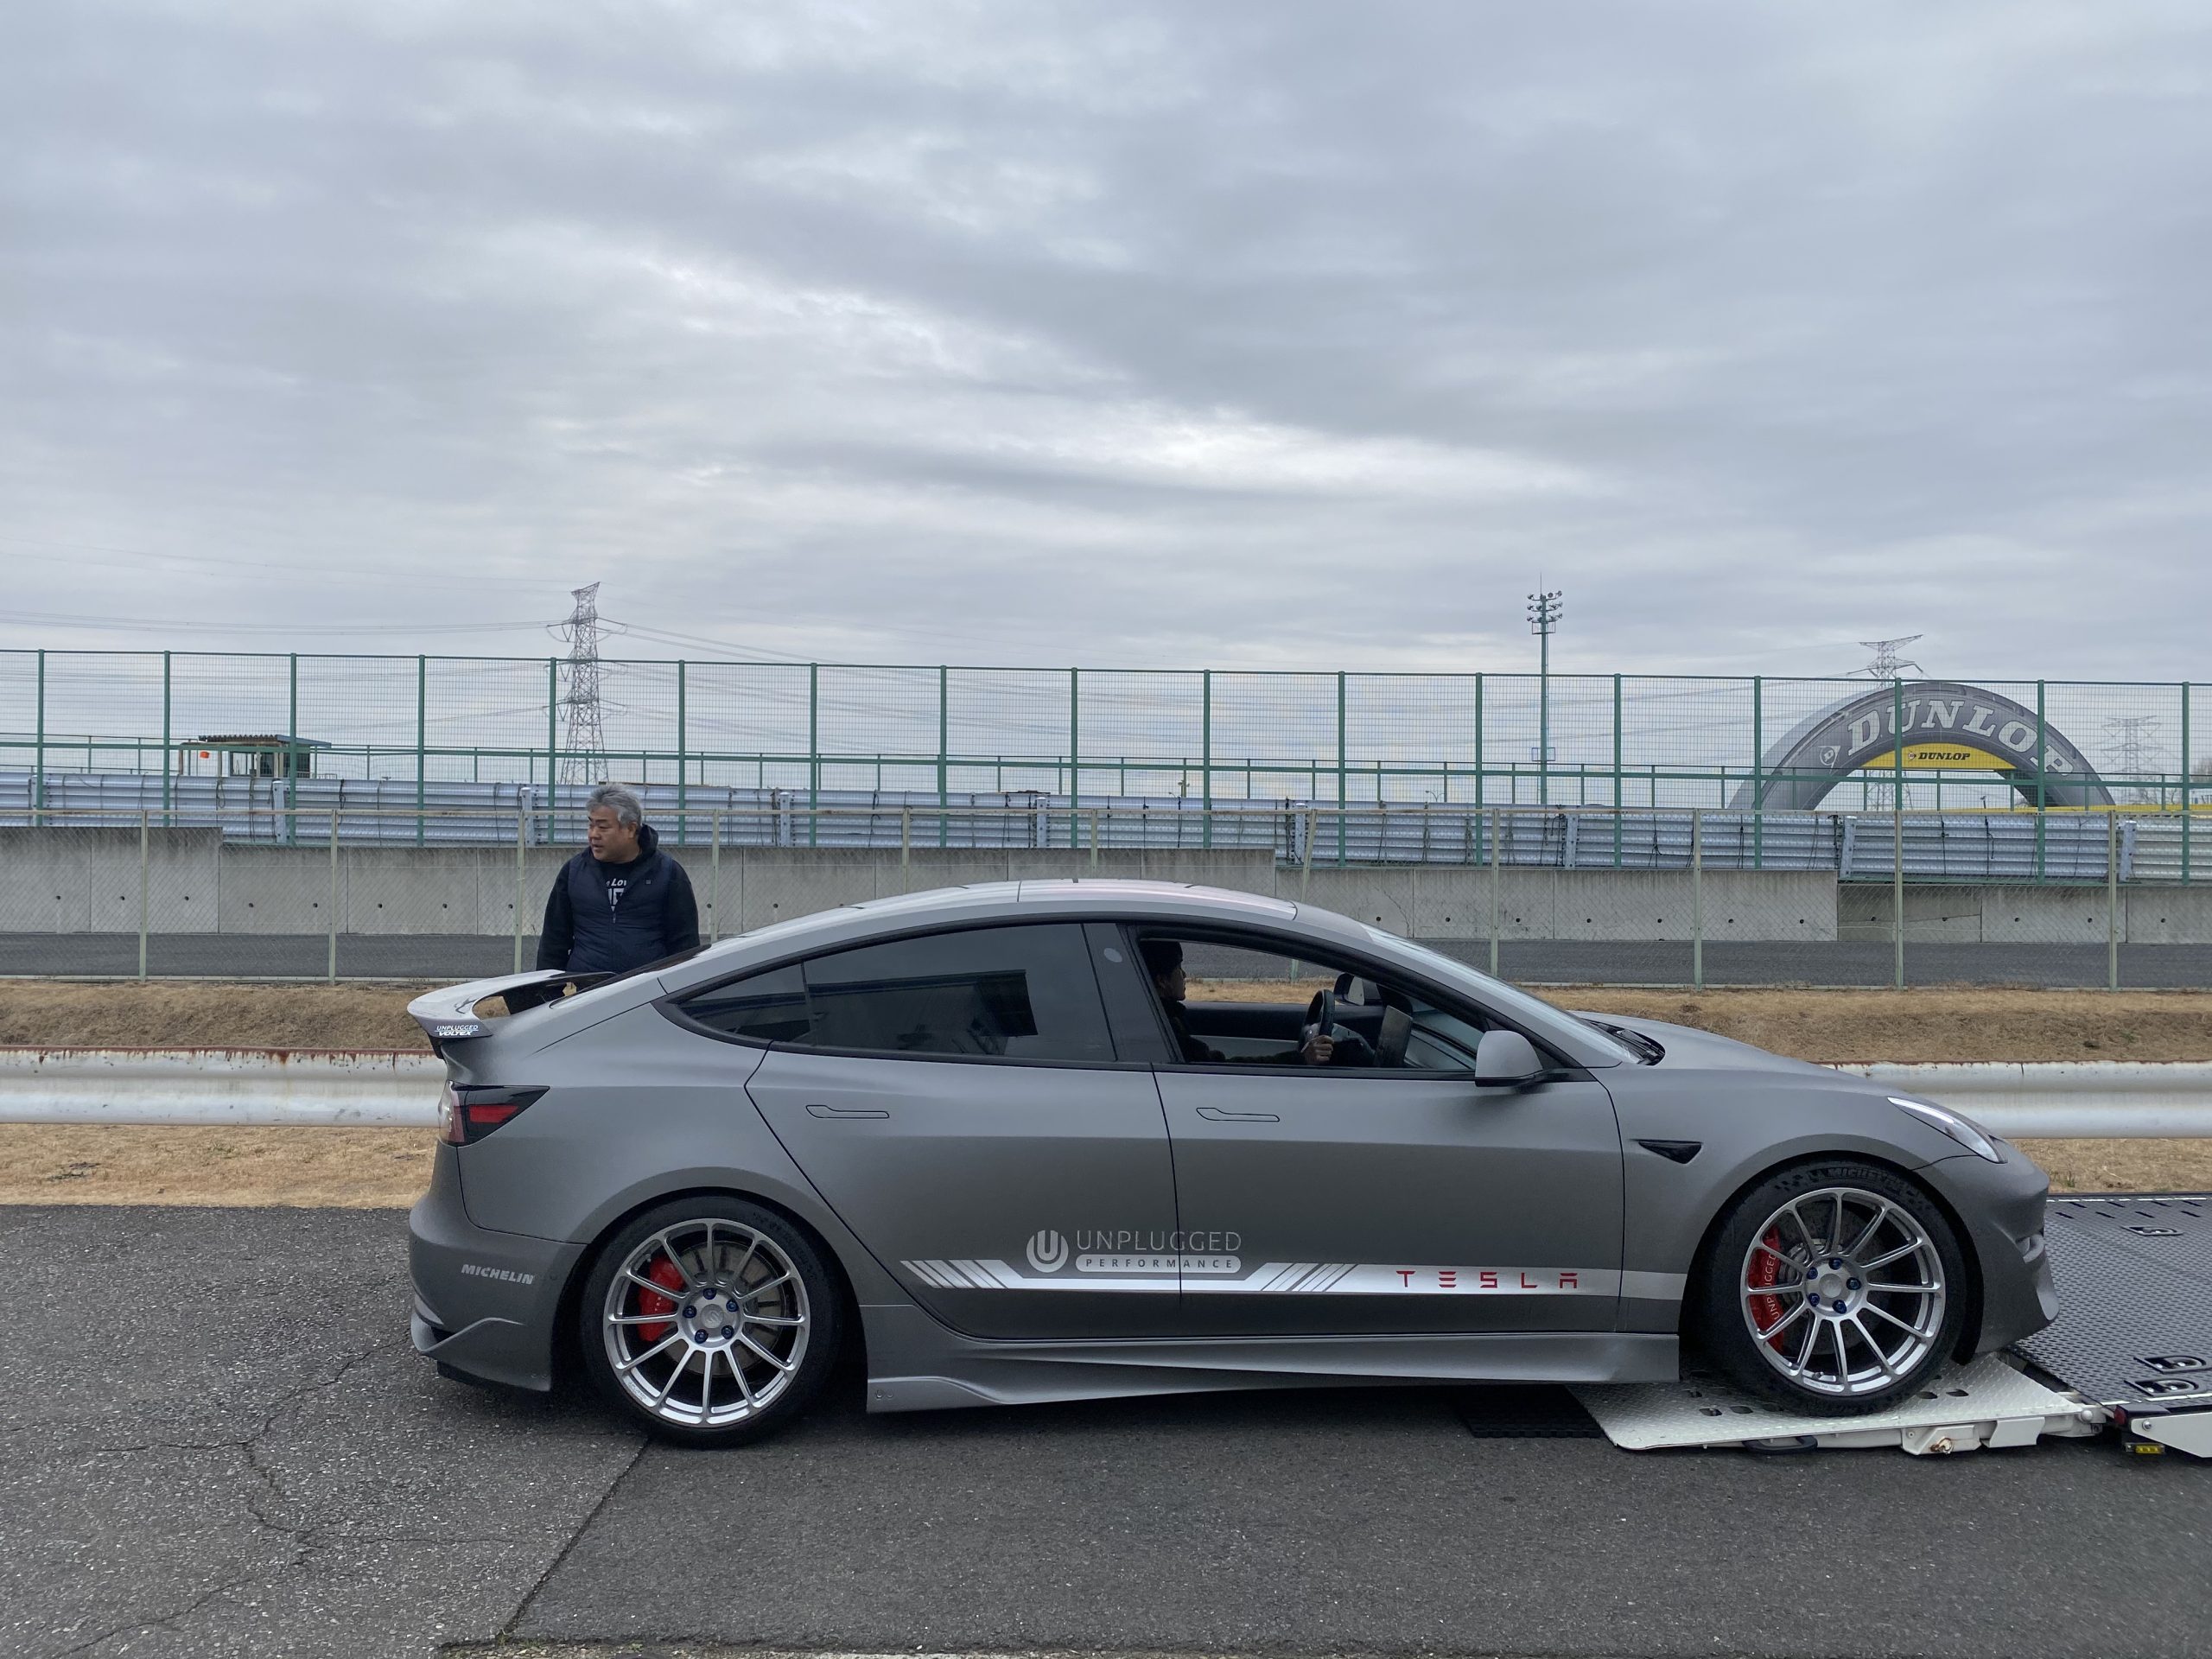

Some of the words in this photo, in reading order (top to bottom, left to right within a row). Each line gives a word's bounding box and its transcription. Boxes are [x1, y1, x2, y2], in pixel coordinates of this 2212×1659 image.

[1847, 699, 2074, 776] DUNLOP
[1918, 752, 1971, 760] DUNLOP
[1077, 1230, 1242, 1251] UNPLUGGED
[1086, 1258, 1232, 1268] PERFORMANCE
[461, 1264, 534, 1285] MICHELIN
[1395, 1270, 1578, 1289] TESLA
